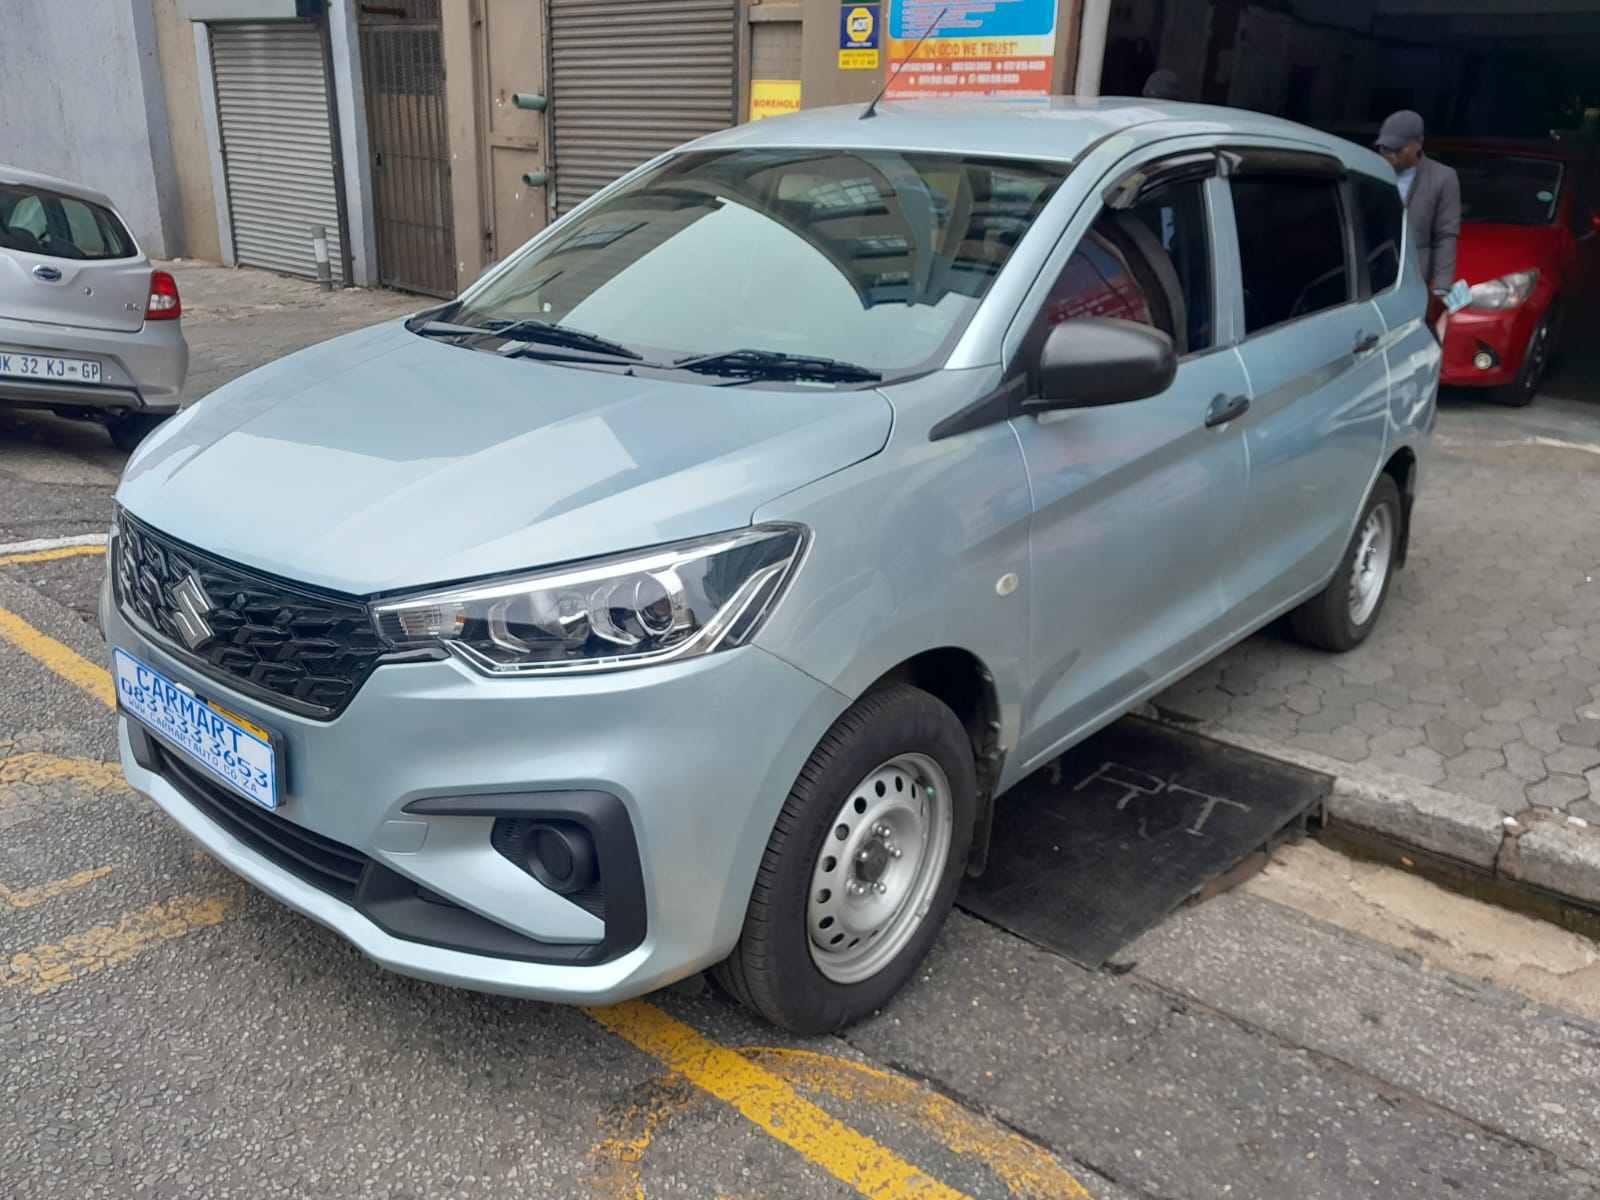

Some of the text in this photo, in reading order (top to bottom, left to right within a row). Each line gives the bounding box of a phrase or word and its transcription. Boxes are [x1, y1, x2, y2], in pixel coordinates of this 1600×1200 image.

[20, 356, 38, 374] 32
[46, 359, 65, 377] KJ
[82, 363, 99, 379] GP
[121, 677, 158, 713] 083
[163, 706, 203, 744] 533
[209, 737, 269, 789] 3653
[136, 665, 242, 754] CARMART
